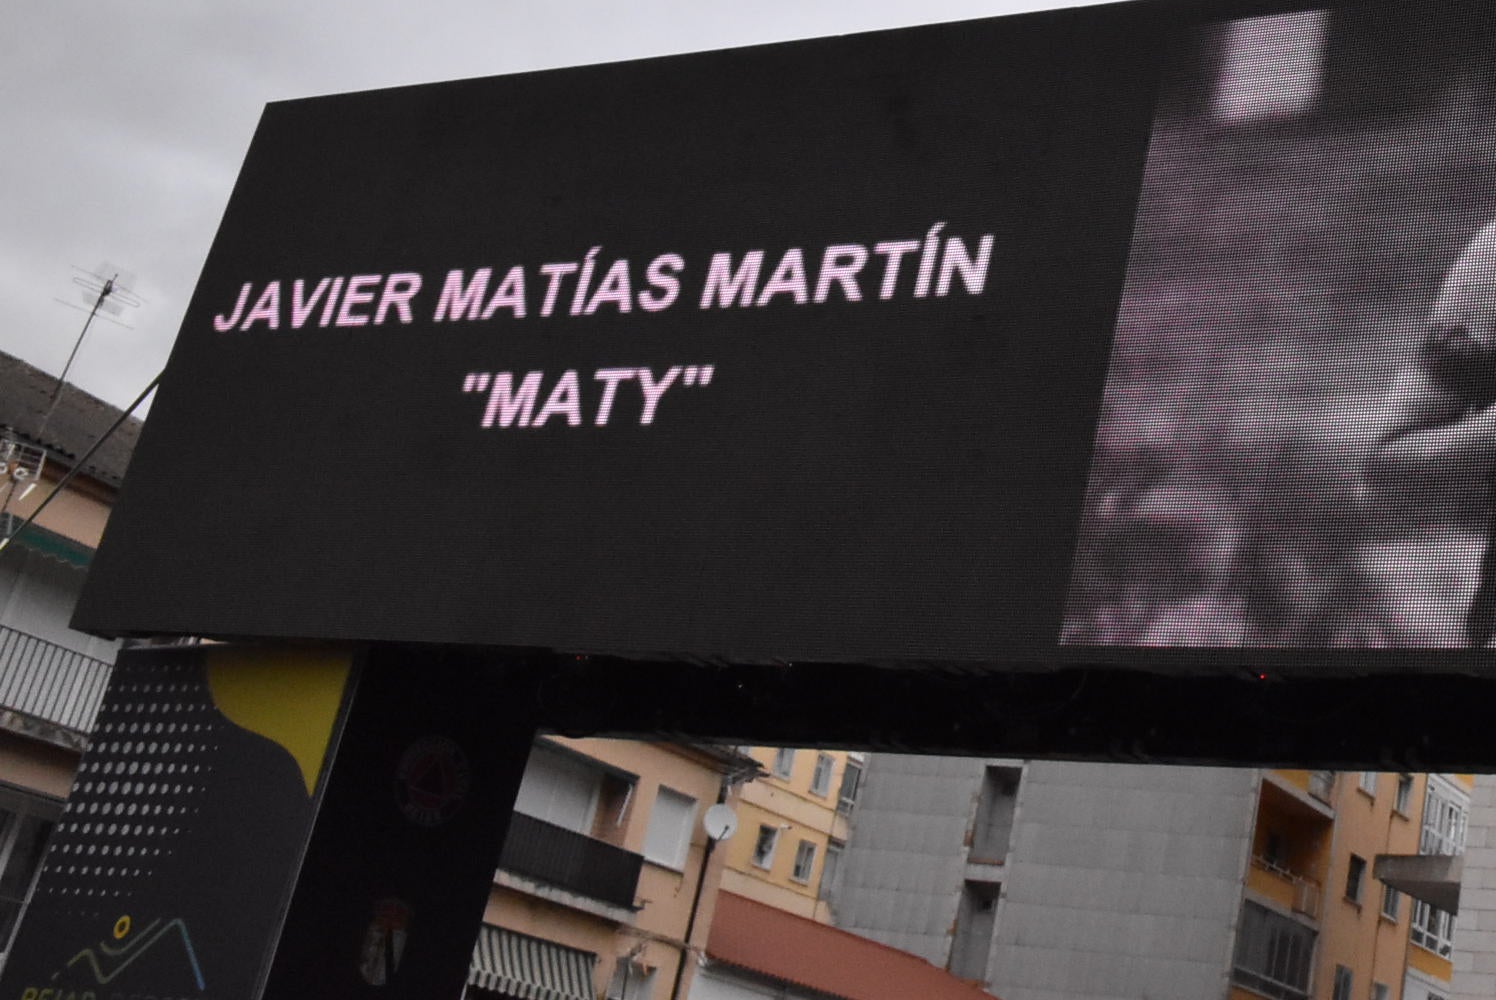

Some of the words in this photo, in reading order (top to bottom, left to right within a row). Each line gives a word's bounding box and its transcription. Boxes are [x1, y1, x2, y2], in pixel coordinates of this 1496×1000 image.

[214, 273, 421, 332] JAVIER
[433, 247, 684, 322] MATÍAS
[700, 222, 994, 308] MARTÍN
[462, 365, 714, 428] "MATY"
